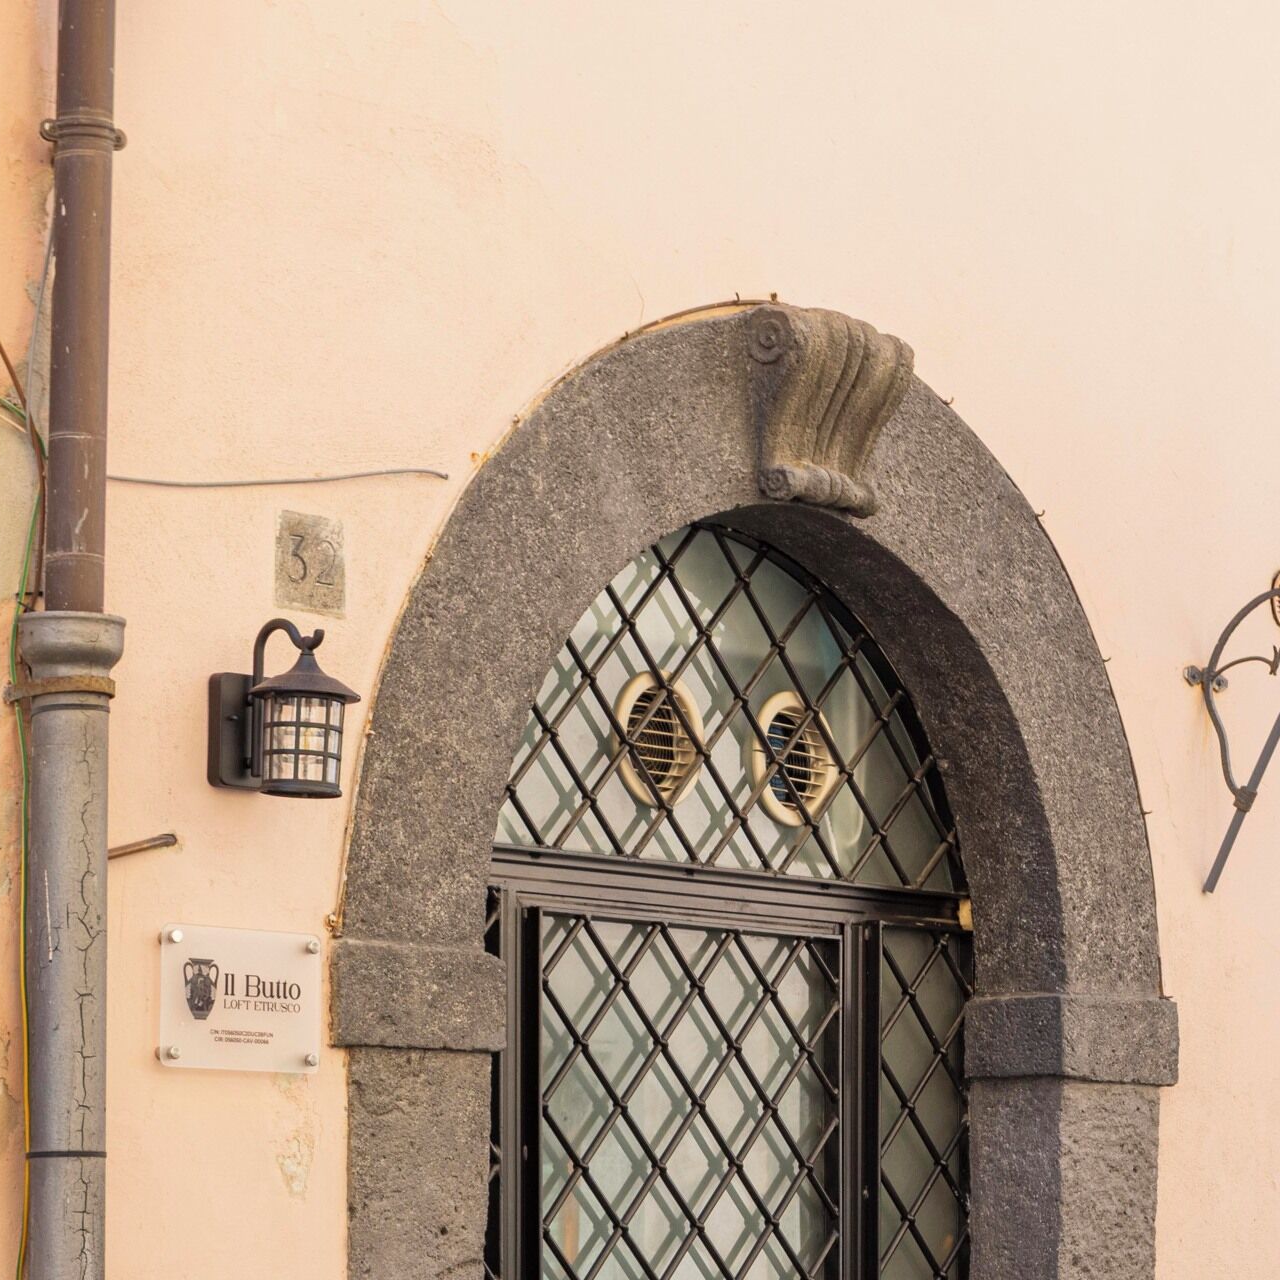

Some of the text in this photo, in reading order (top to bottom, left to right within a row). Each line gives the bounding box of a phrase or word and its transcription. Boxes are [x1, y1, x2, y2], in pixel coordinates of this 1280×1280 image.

[287, 533, 336, 588] 32
[224, 973, 301, 1000] Il Butto
[223, 998, 301, 1013] LOFT ETRUSCO
